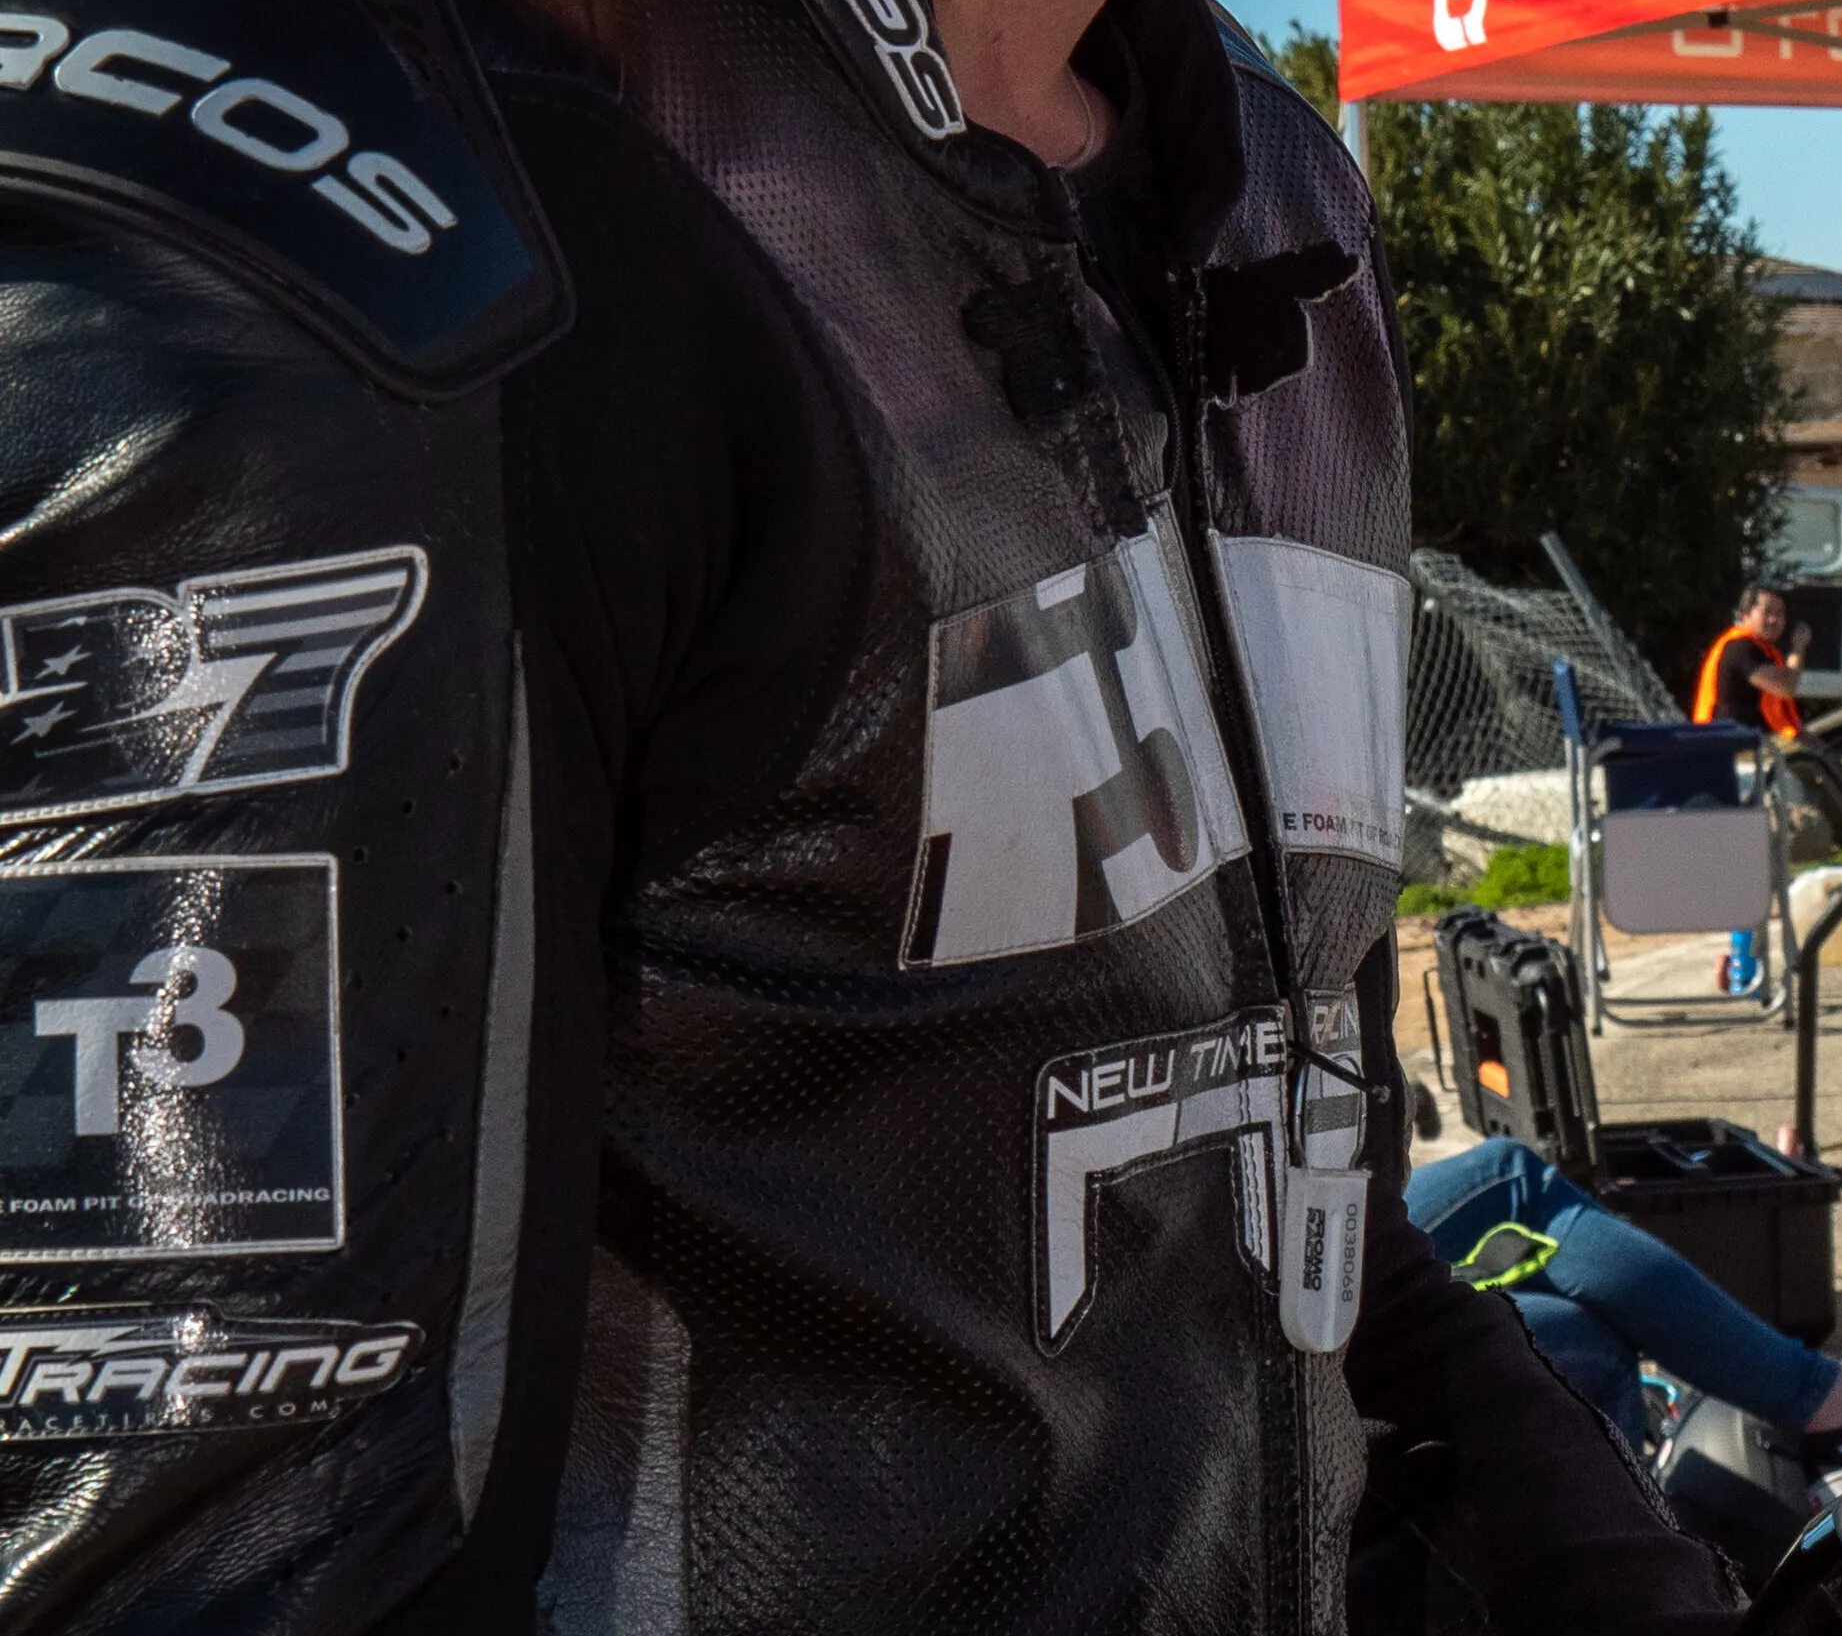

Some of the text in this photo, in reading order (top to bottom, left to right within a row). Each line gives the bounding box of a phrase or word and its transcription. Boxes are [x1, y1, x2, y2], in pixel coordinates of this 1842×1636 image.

[1046, 1049, 1175, 1120] NEW
[1190, 1020, 1280, 1082] TIME
[10, 1196, 77, 1214] FOAM
[83, 1194, 122, 1212] PIT
[1341, 1203, 1358, 1303] 0038068
